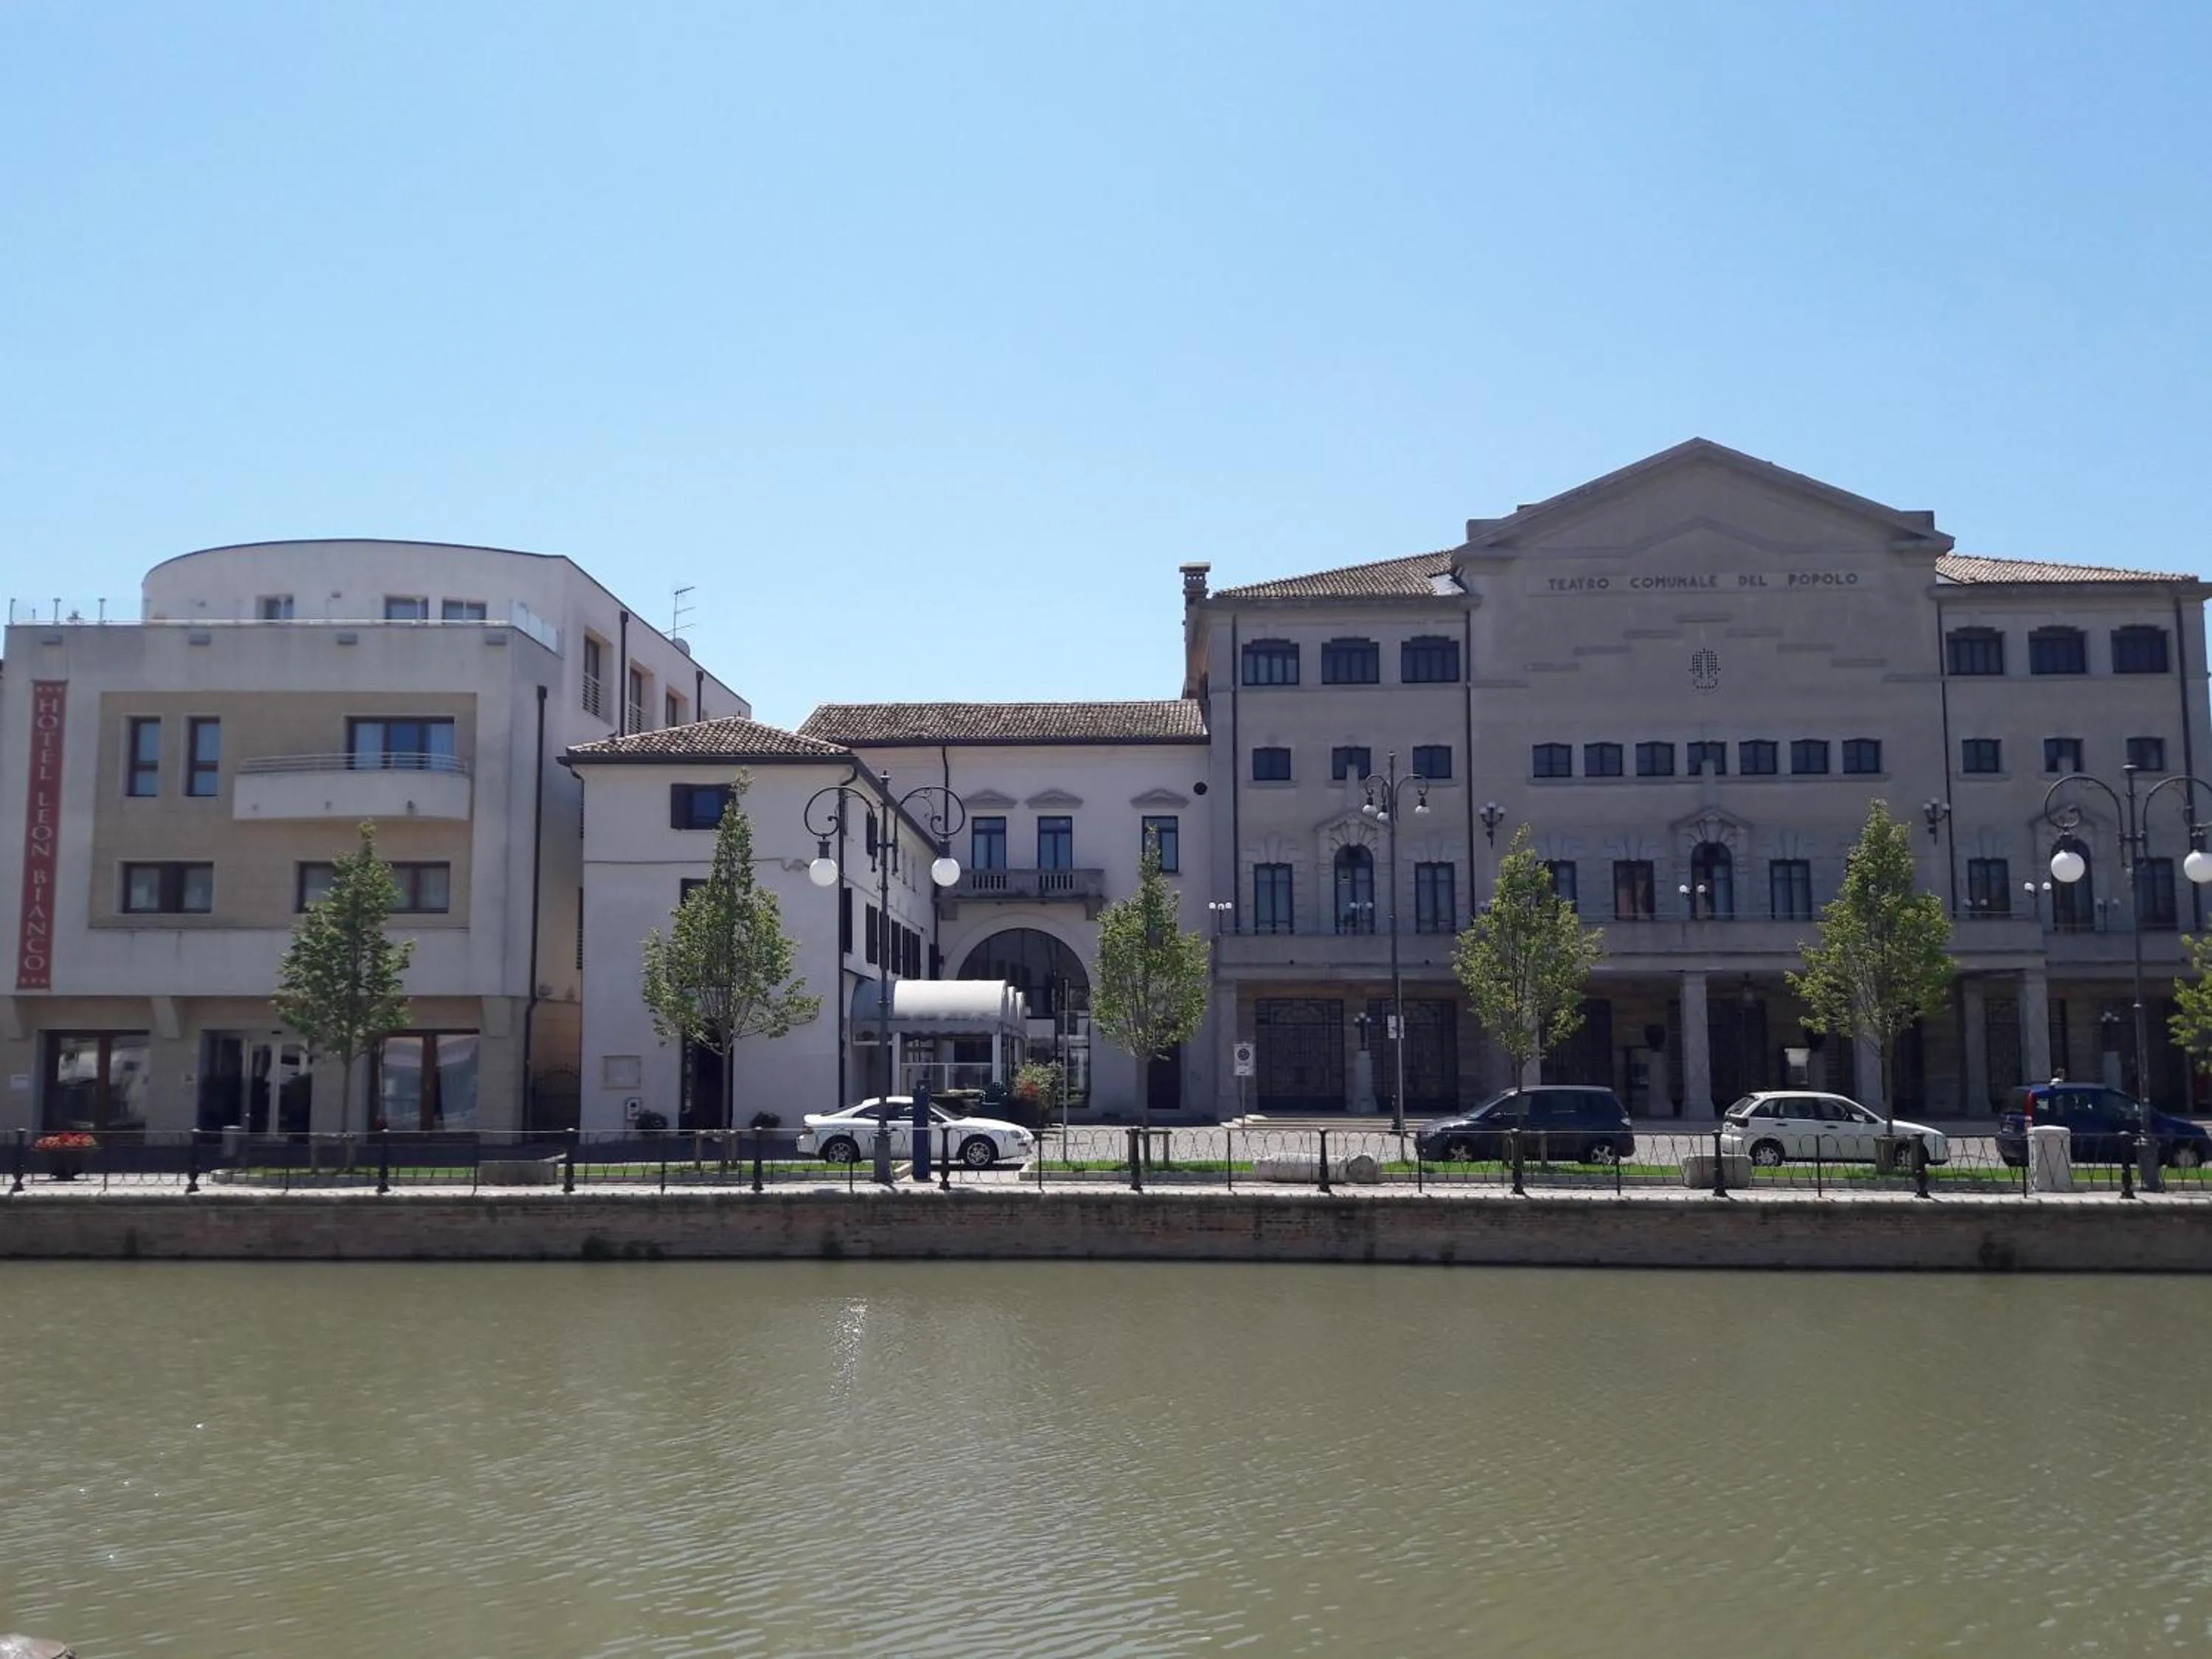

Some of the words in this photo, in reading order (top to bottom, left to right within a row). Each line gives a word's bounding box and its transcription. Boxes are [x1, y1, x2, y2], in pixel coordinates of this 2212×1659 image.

[1548, 578, 1610, 590] TEATRO
[1630, 576, 1718, 589] COMUNALE
[1738, 575, 1767, 587] DEL
[1789, 573, 1858, 587] POPOLO
[37, 698, 58, 779] HOTEL
[32, 791, 52, 858] LEON
[24, 869, 46, 970] BIANCO
